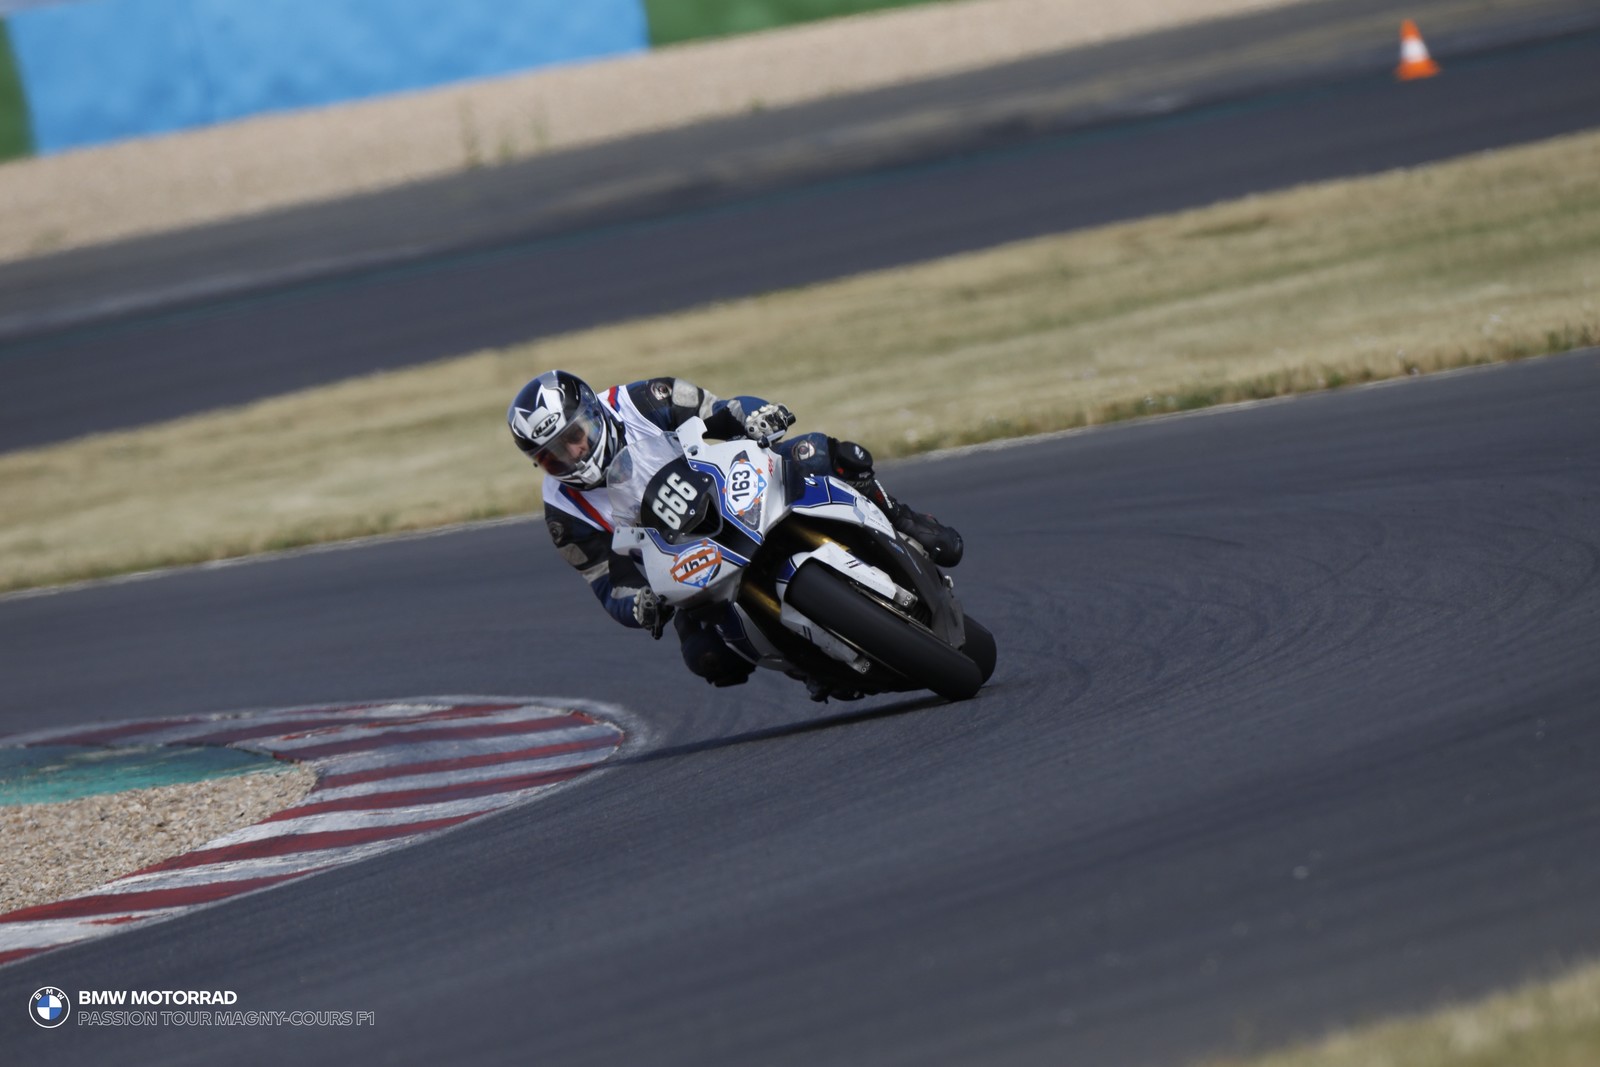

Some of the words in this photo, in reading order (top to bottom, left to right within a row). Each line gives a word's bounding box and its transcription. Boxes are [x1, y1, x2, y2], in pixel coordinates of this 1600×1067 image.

[534, 414, 556, 436] HJC
[652, 472, 698, 530] 666
[732, 470, 751, 502] 163
